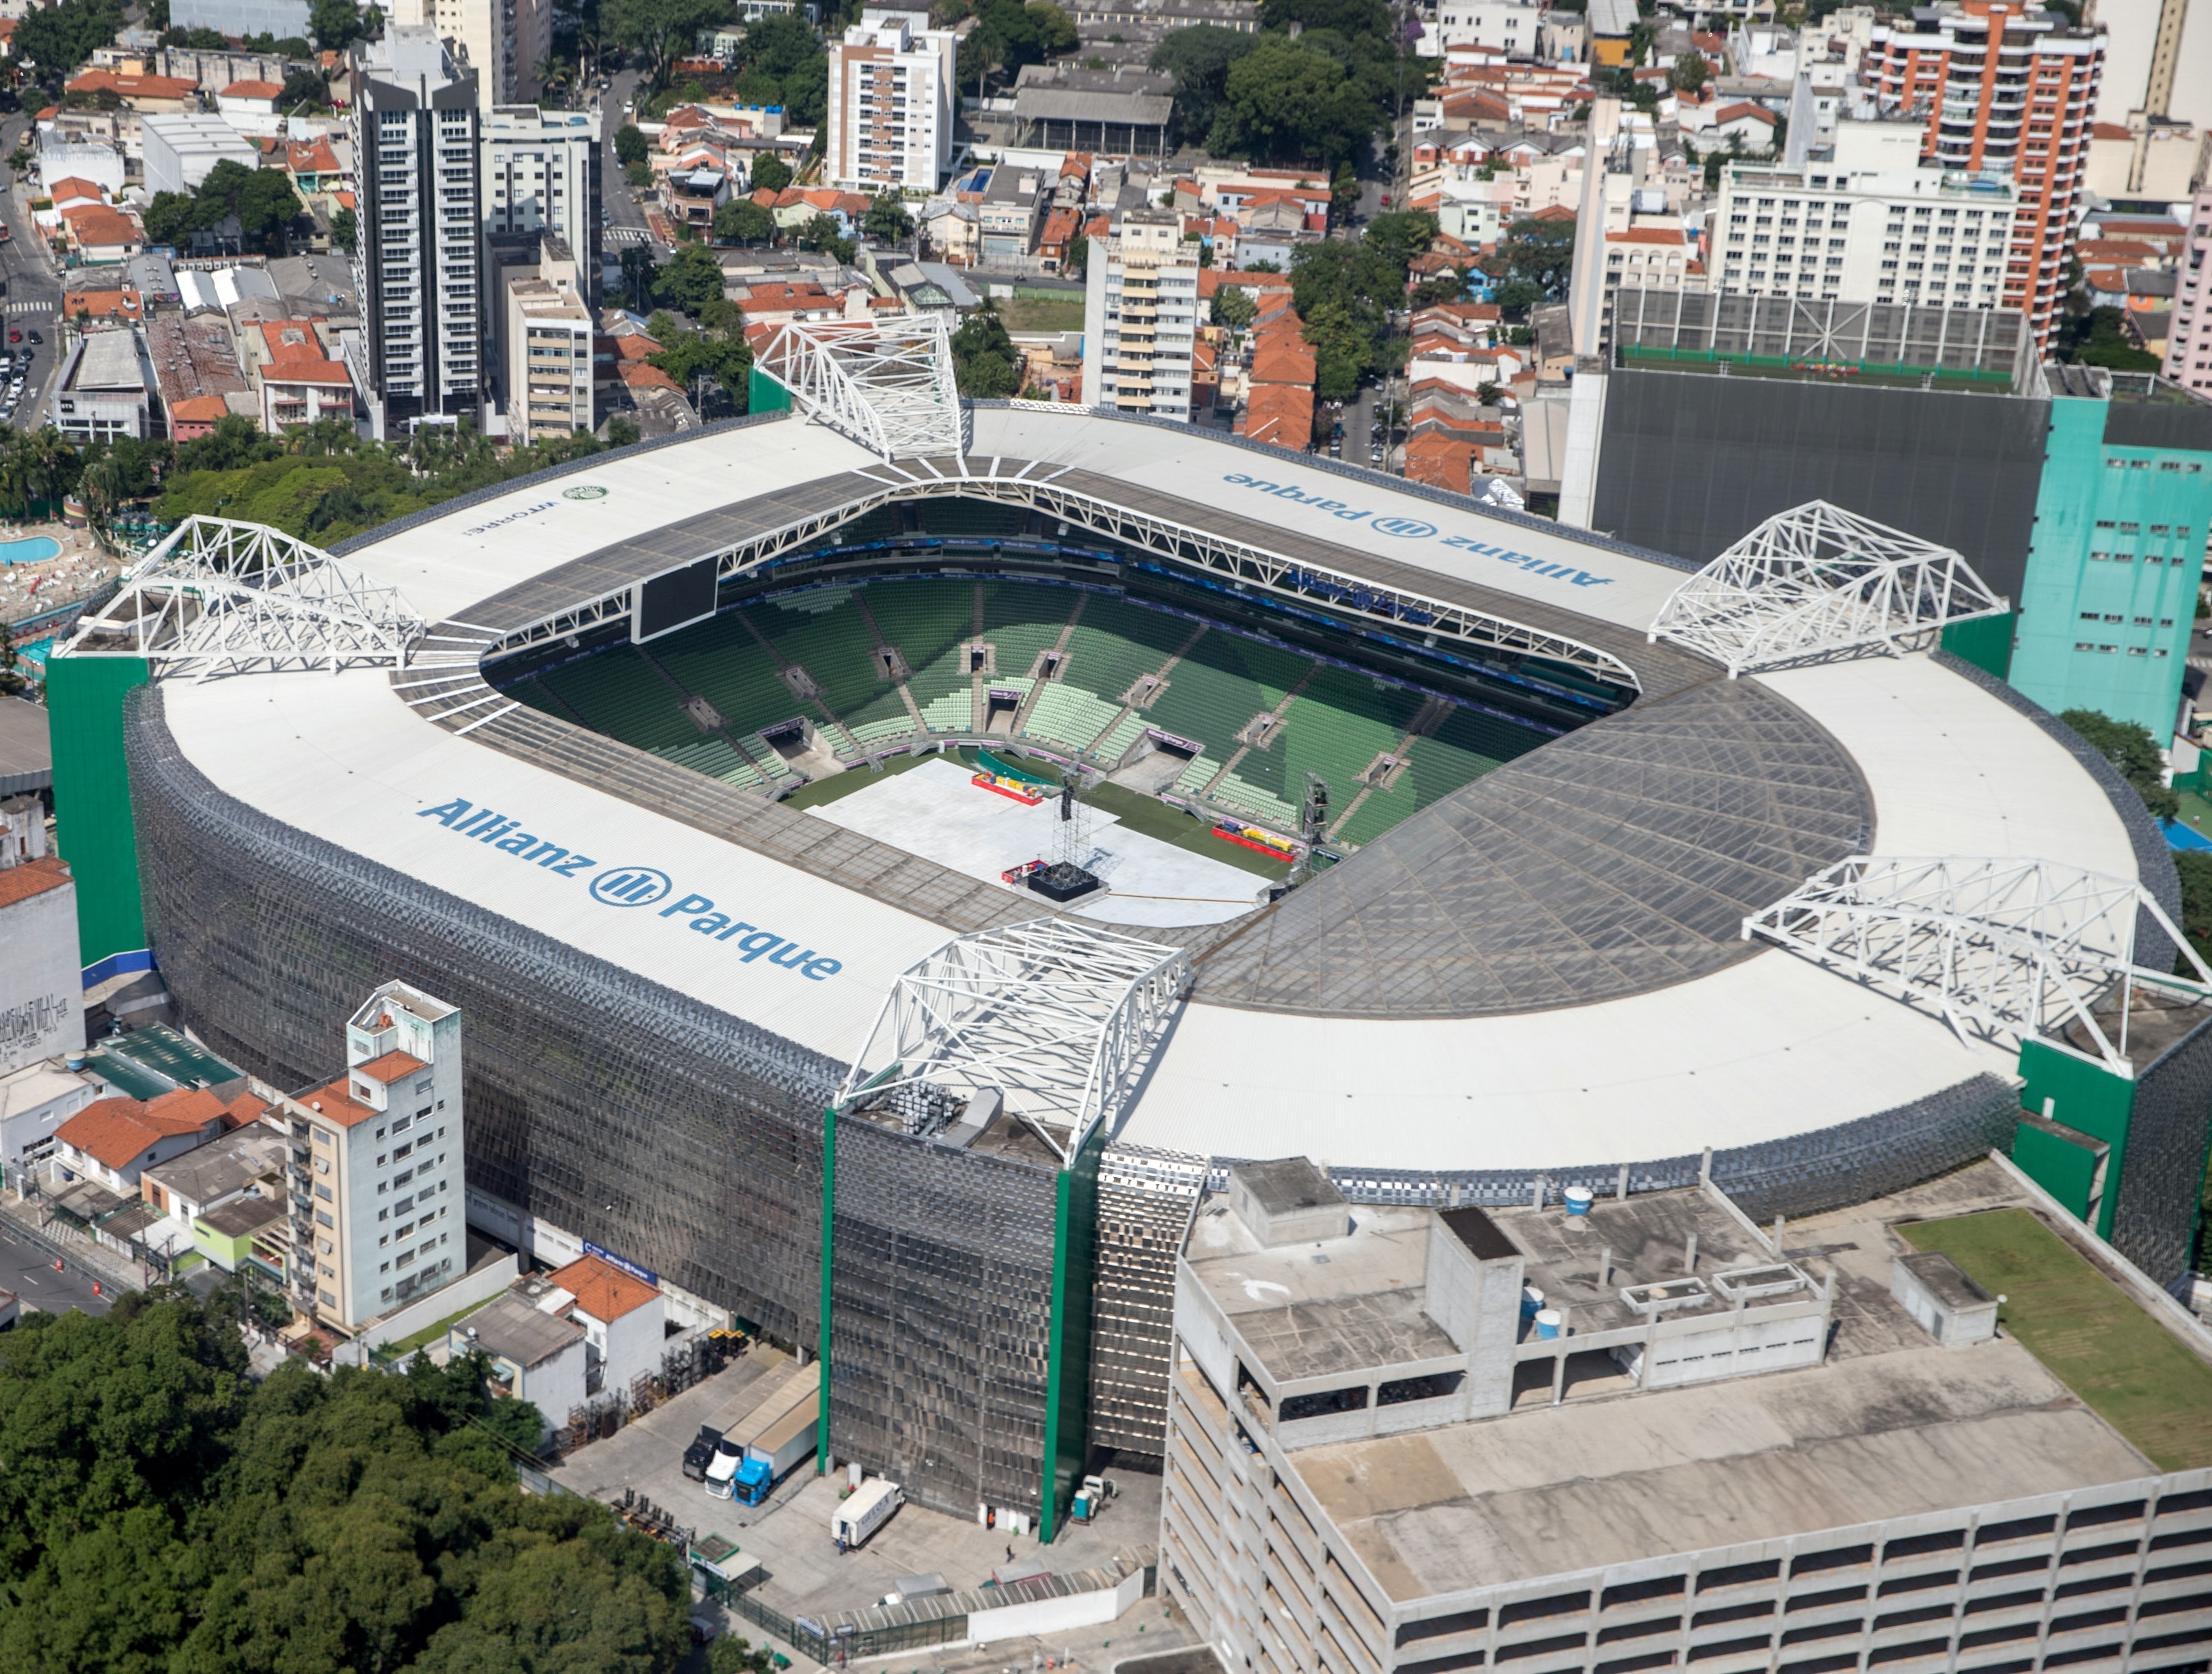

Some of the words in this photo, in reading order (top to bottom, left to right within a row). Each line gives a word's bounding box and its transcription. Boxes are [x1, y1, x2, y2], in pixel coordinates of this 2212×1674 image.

[1223, 472, 1373, 520] Parque
[1440, 535, 1617, 588] Allianz
[1287, 569, 1348, 600] Allianz
[1377, 593, 1436, 626] Parque
[416, 798, 597, 878] Allianz
[658, 893, 843, 982] Parque
